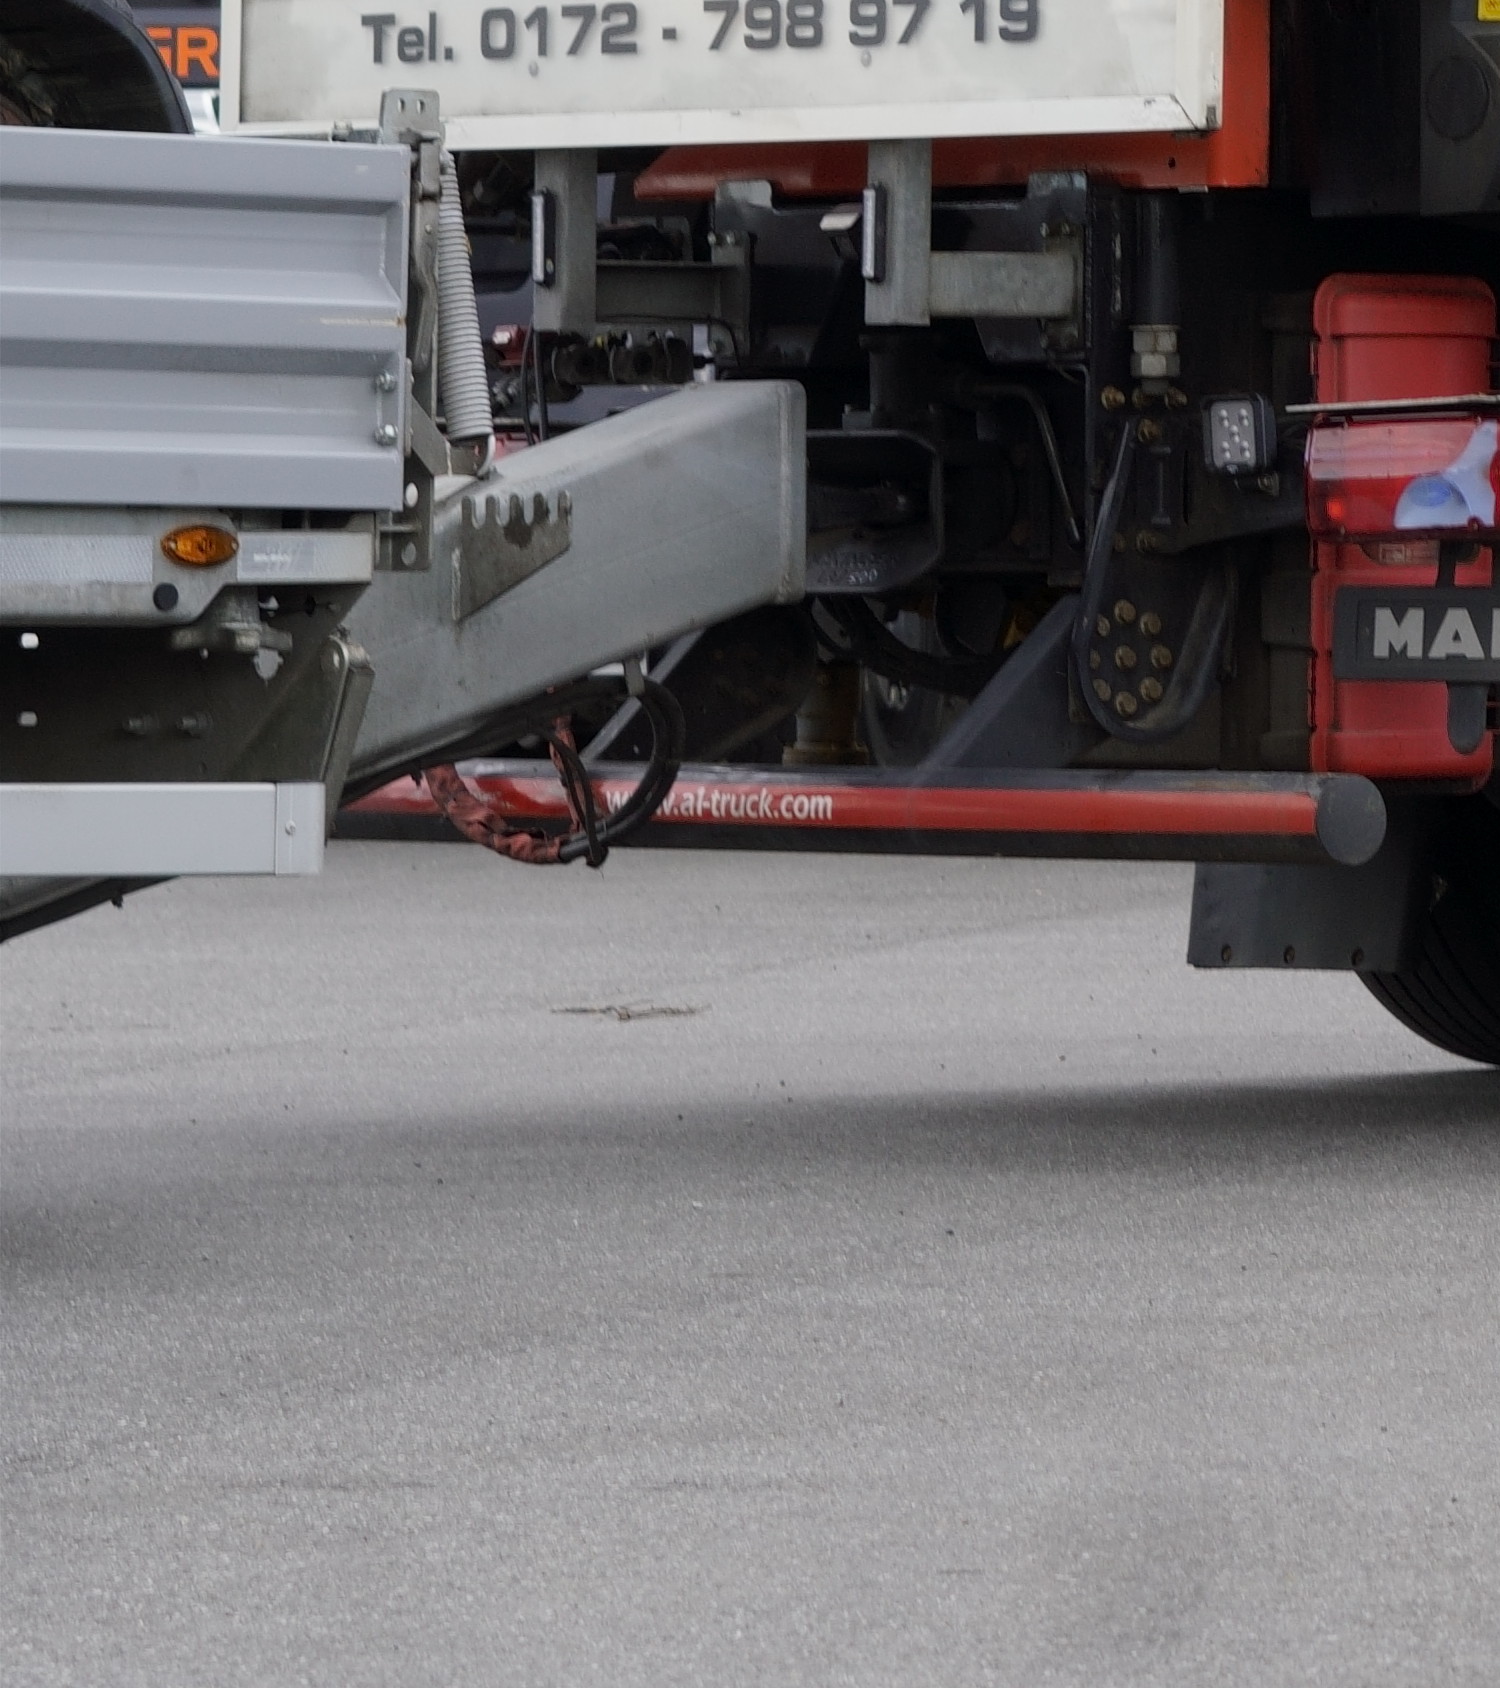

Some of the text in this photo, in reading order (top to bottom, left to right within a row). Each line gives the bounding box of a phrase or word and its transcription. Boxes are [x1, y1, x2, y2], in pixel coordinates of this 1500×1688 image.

[361, 11, 455, 64] Tel.
[479, 1, 638, 60] 0172
[605, 785, 833, 820] ww.al-truck.com
